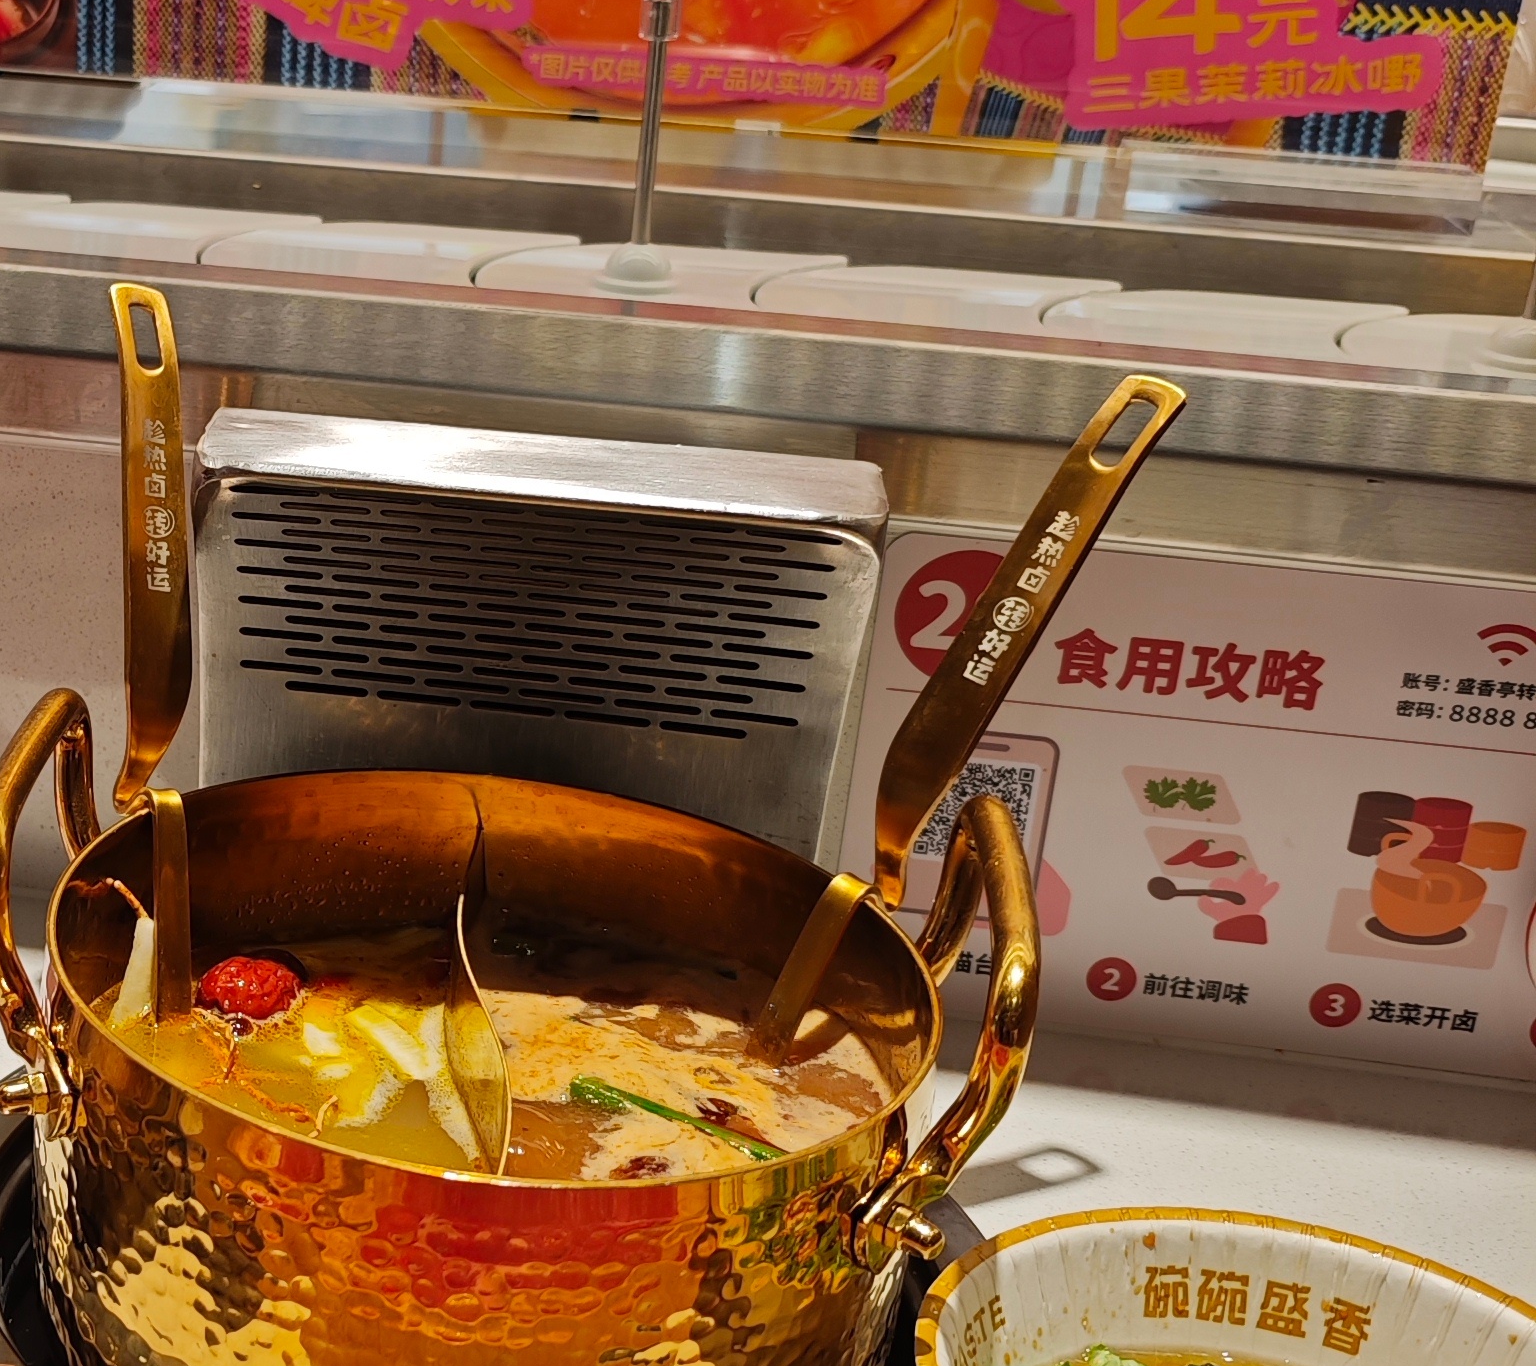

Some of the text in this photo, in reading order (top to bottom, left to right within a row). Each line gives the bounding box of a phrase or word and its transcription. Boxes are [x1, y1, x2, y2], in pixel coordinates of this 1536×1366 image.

[530, 53, 694, 90] 图片仅供考
[1054, 627, 1326, 711] 食用攻略
[1100, 967, 1250, 1006] 2 前往调味
[1323, 992, 1478, 1034] 3 选菜开卤
[1143, 1265, 1373, 1356] 碗碗盛香
